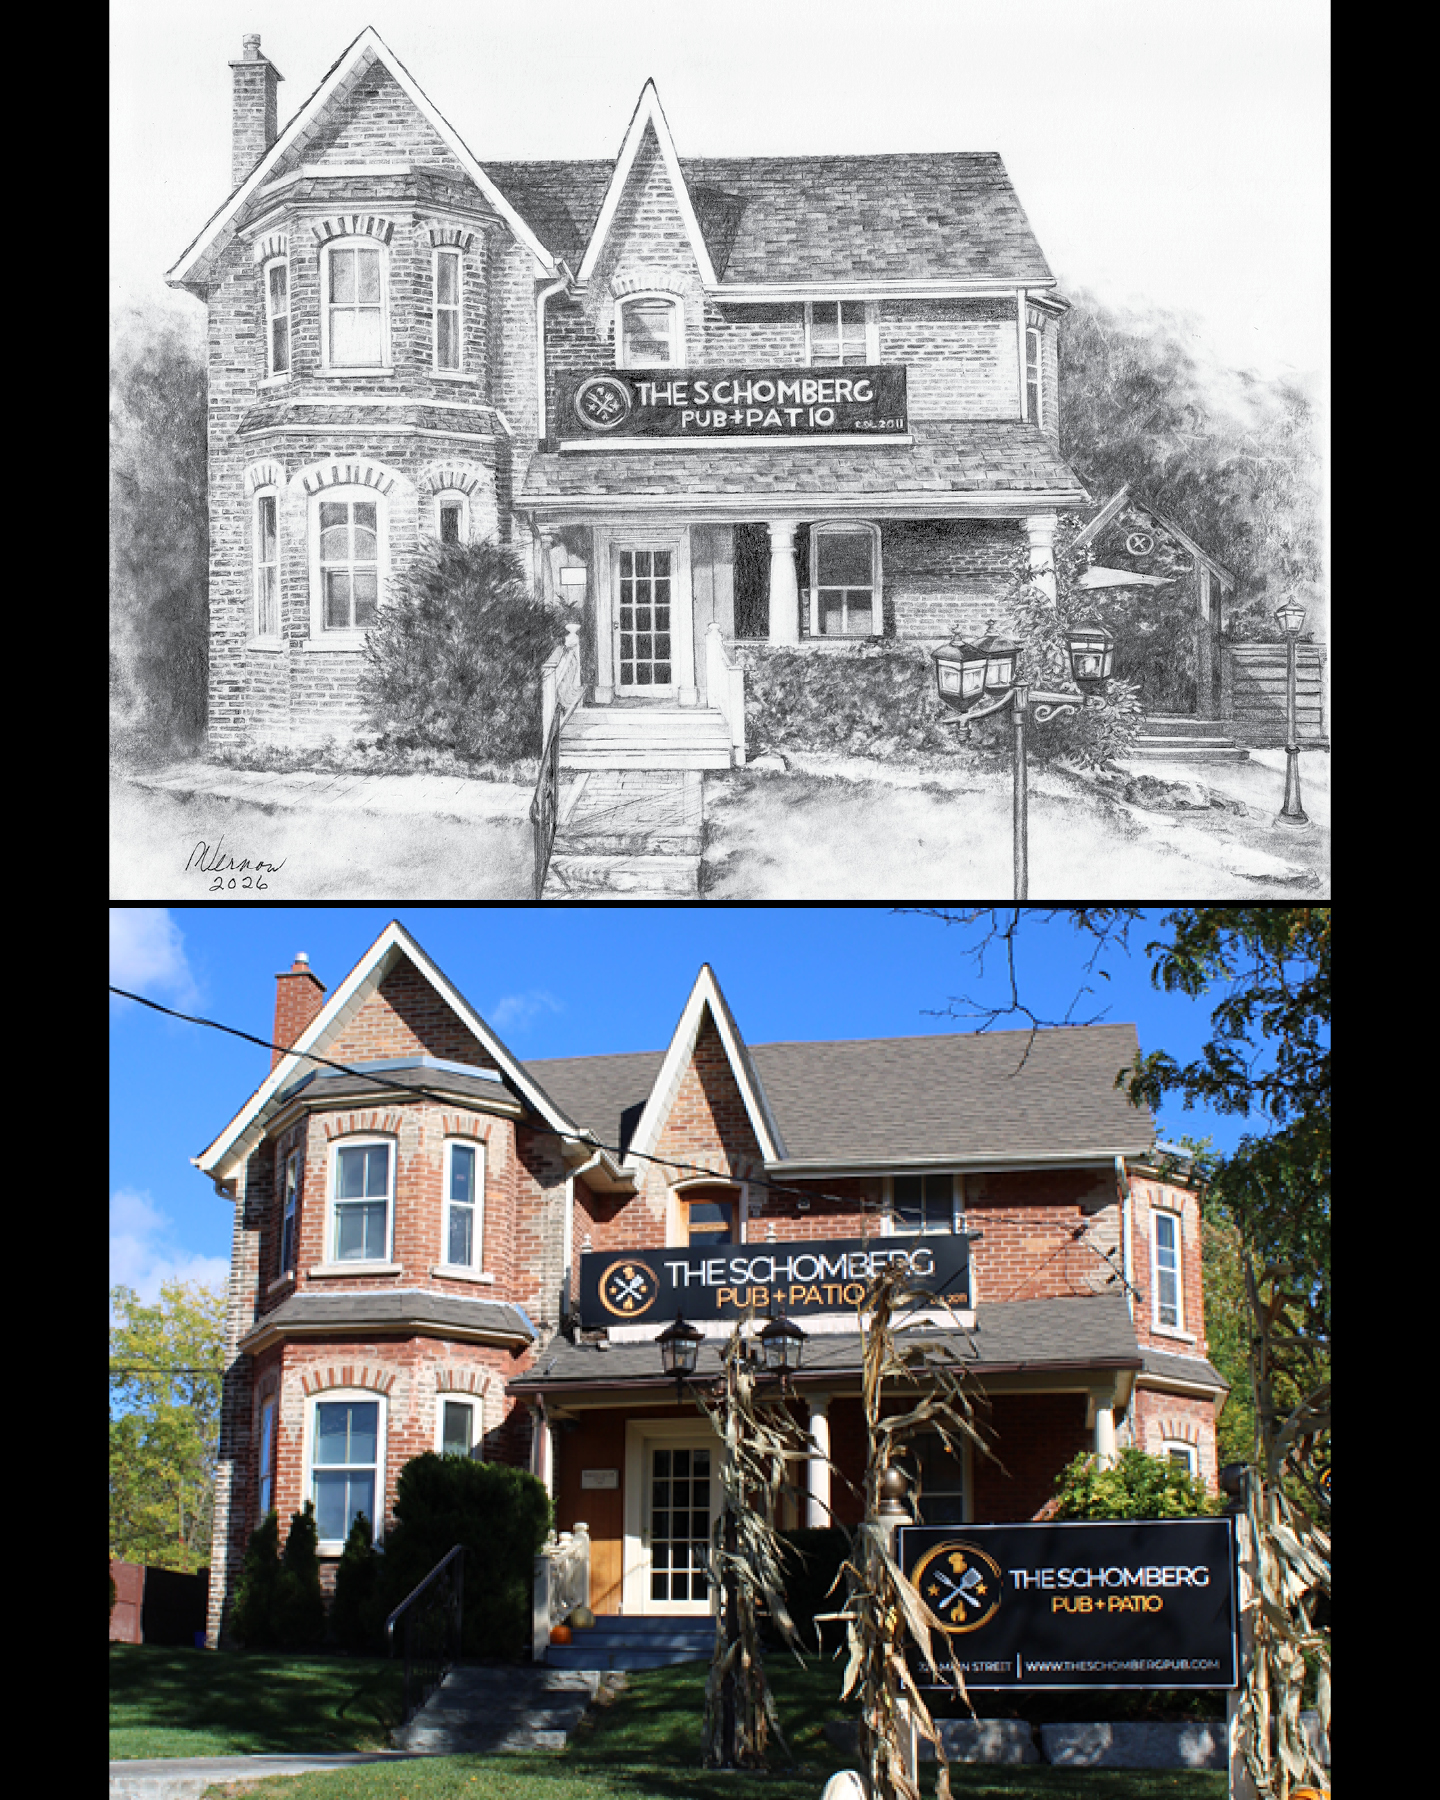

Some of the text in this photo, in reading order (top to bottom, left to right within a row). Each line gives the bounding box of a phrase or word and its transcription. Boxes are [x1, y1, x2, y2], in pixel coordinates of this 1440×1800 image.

[635, 378, 875, 407] THE SCHOMBERG
[879, 419, 904, 429] 2011
[208, 875, 269, 892] 2026
[664, 1259, 727, 1287] THE
[716, 1285, 770, 1309] PUB
[788, 1281, 866, 1305] PATIO
[1008, 1565, 1211, 1590] THE SCHOMBERG
[1051, 1594, 1094, 1613] PUB
[1107, 1594, 1164, 1613] PATIO
[938, 1661, 970, 1672] MAN
